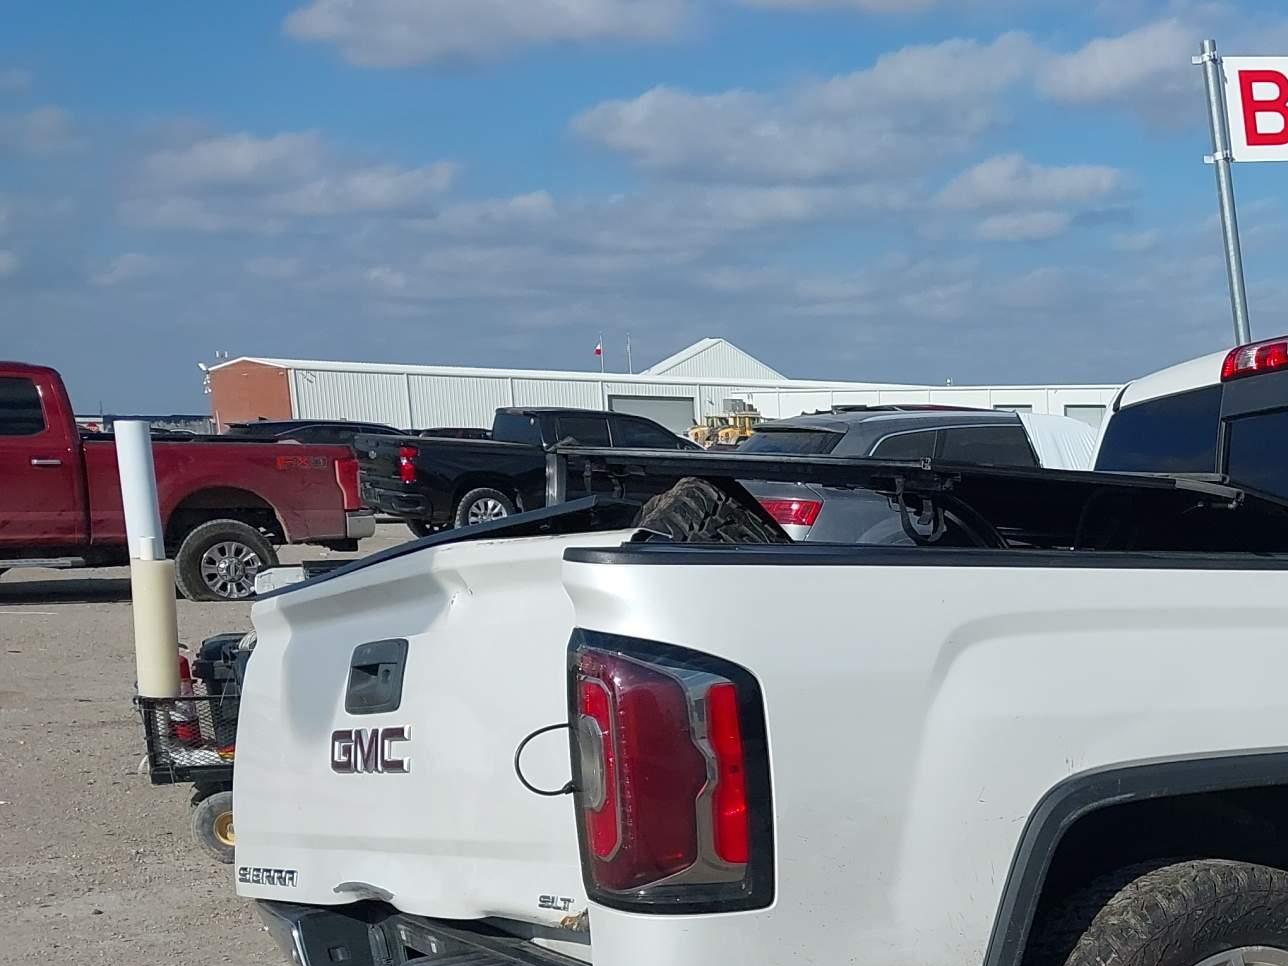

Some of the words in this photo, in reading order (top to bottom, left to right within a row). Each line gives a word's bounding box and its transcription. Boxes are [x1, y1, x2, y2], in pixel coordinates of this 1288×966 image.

[331, 724, 412, 774] GMC
[239, 866, 299, 888] SIERRA
[537, 895, 575, 912] SLT
